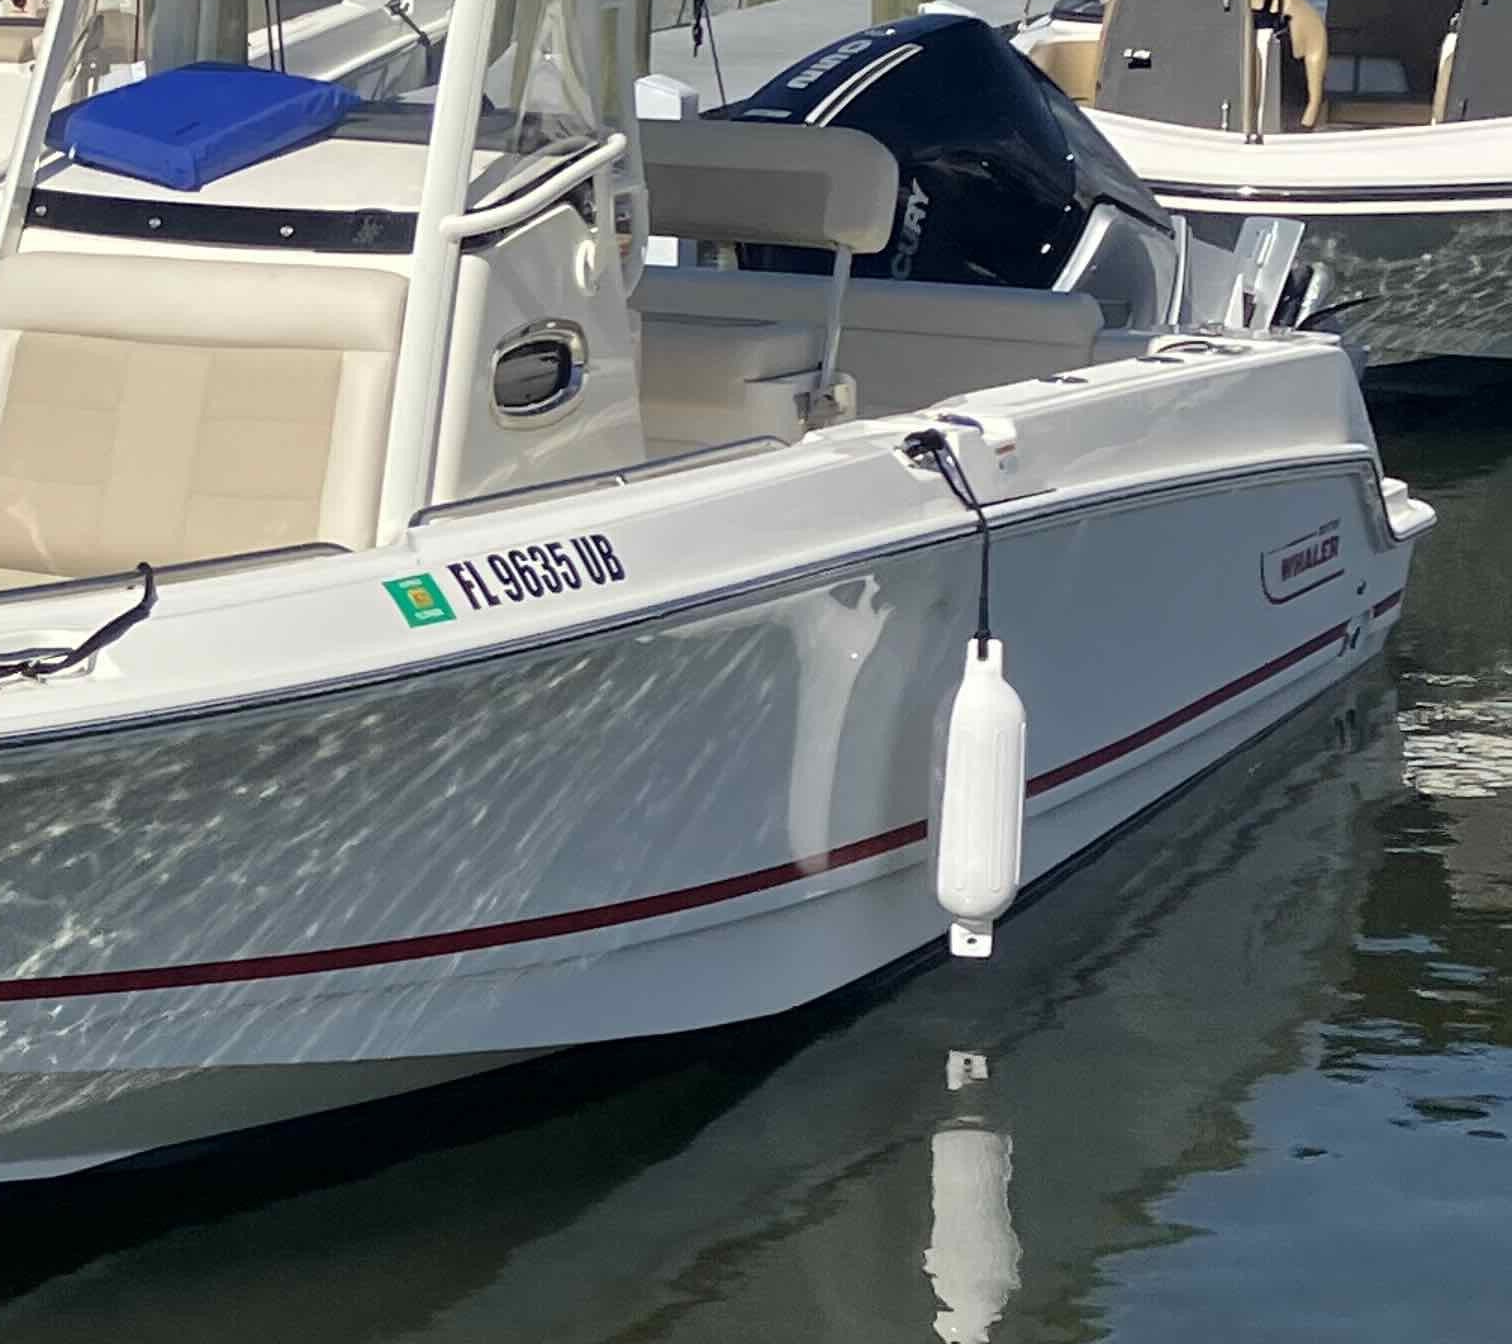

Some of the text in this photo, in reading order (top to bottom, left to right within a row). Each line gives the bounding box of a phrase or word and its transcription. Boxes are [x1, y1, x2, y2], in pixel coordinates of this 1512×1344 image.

[447, 533, 626, 610] FL 9635 UB
[1281, 535, 1340, 581] WHALER
